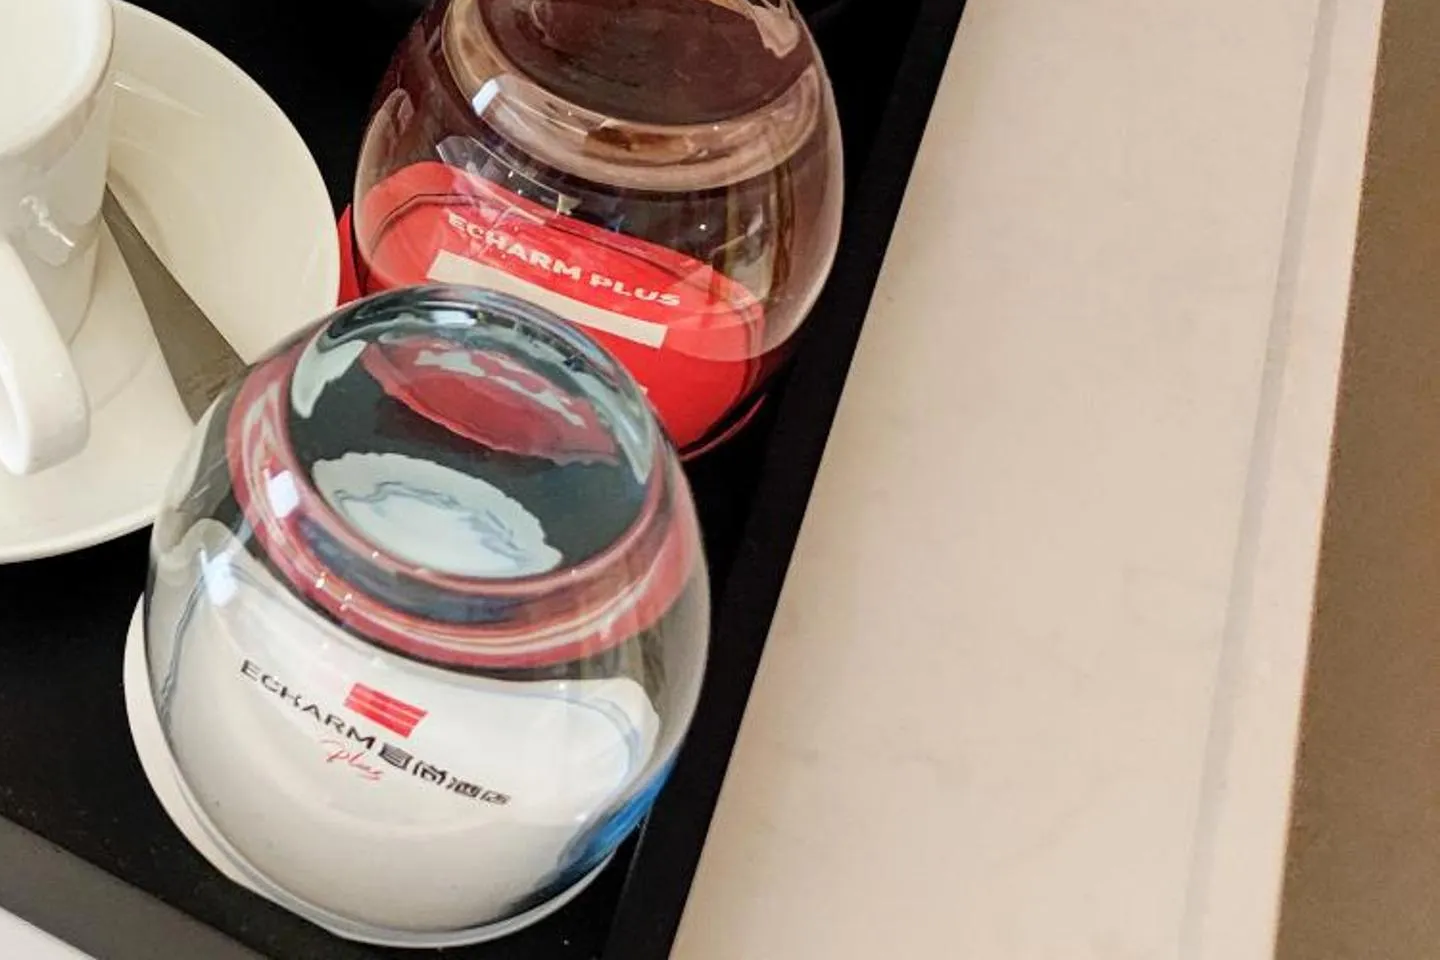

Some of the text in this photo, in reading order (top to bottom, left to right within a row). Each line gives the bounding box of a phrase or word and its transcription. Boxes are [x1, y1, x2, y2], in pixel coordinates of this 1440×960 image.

[448, 211, 681, 307] ECHARM PLUS
[240, 658, 377, 750] ECHARM
